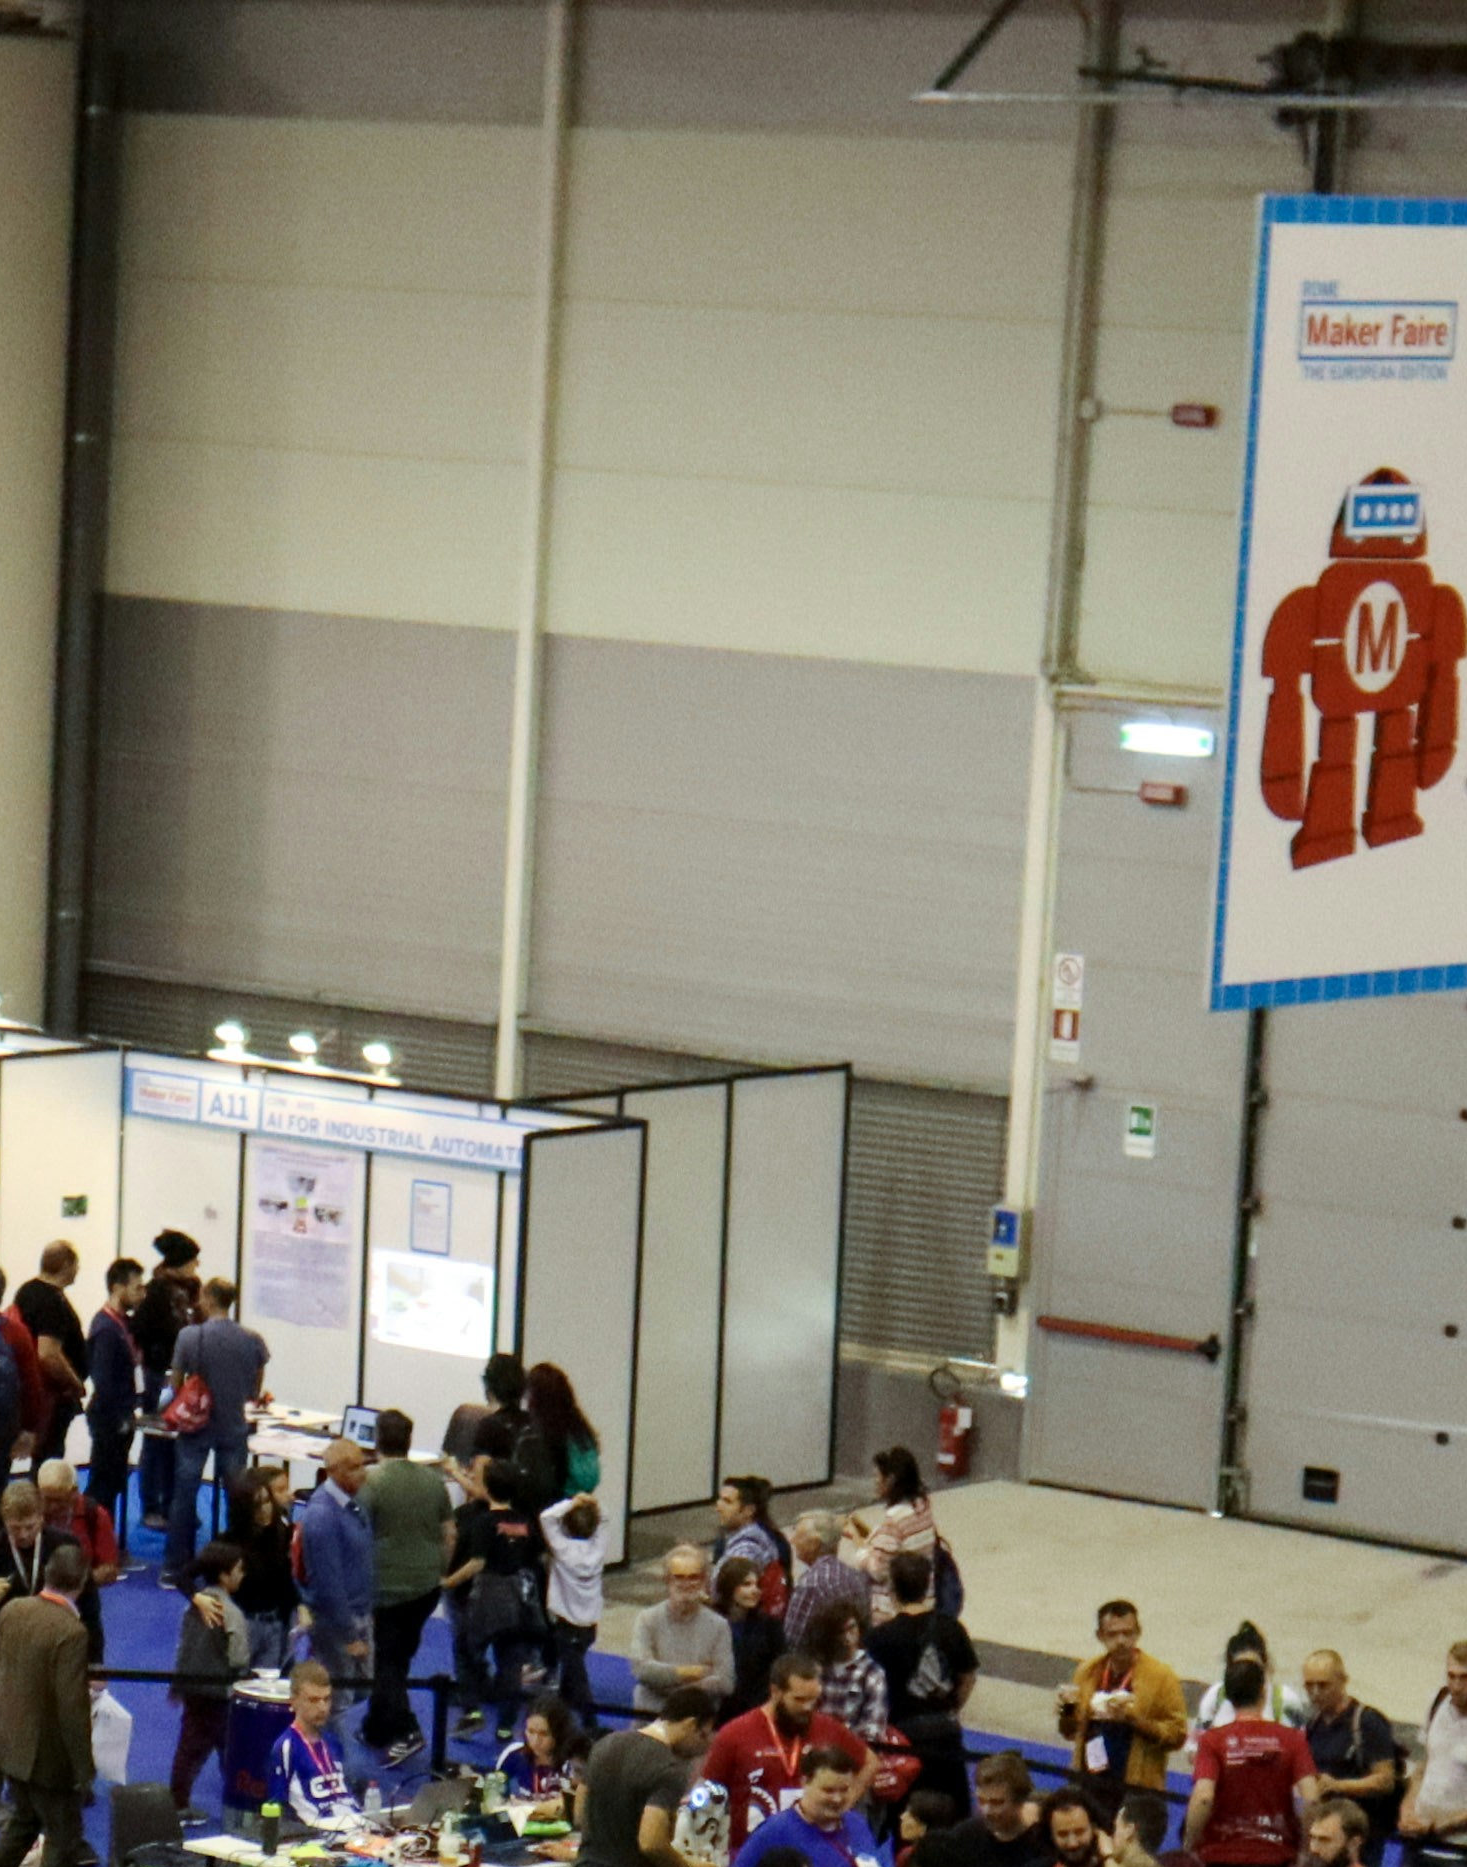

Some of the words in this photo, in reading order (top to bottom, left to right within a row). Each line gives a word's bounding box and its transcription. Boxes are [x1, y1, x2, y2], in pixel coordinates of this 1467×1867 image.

[1307, 314, 1382, 346] Maker
[1391, 314, 1448, 346] Faire
[208, 1092, 249, 1122] A11
[267, 1111, 284, 1128] AI
[288, 1114, 320, 1133] FOR
[324, 1119, 424, 1150] INDUSTRIAL
